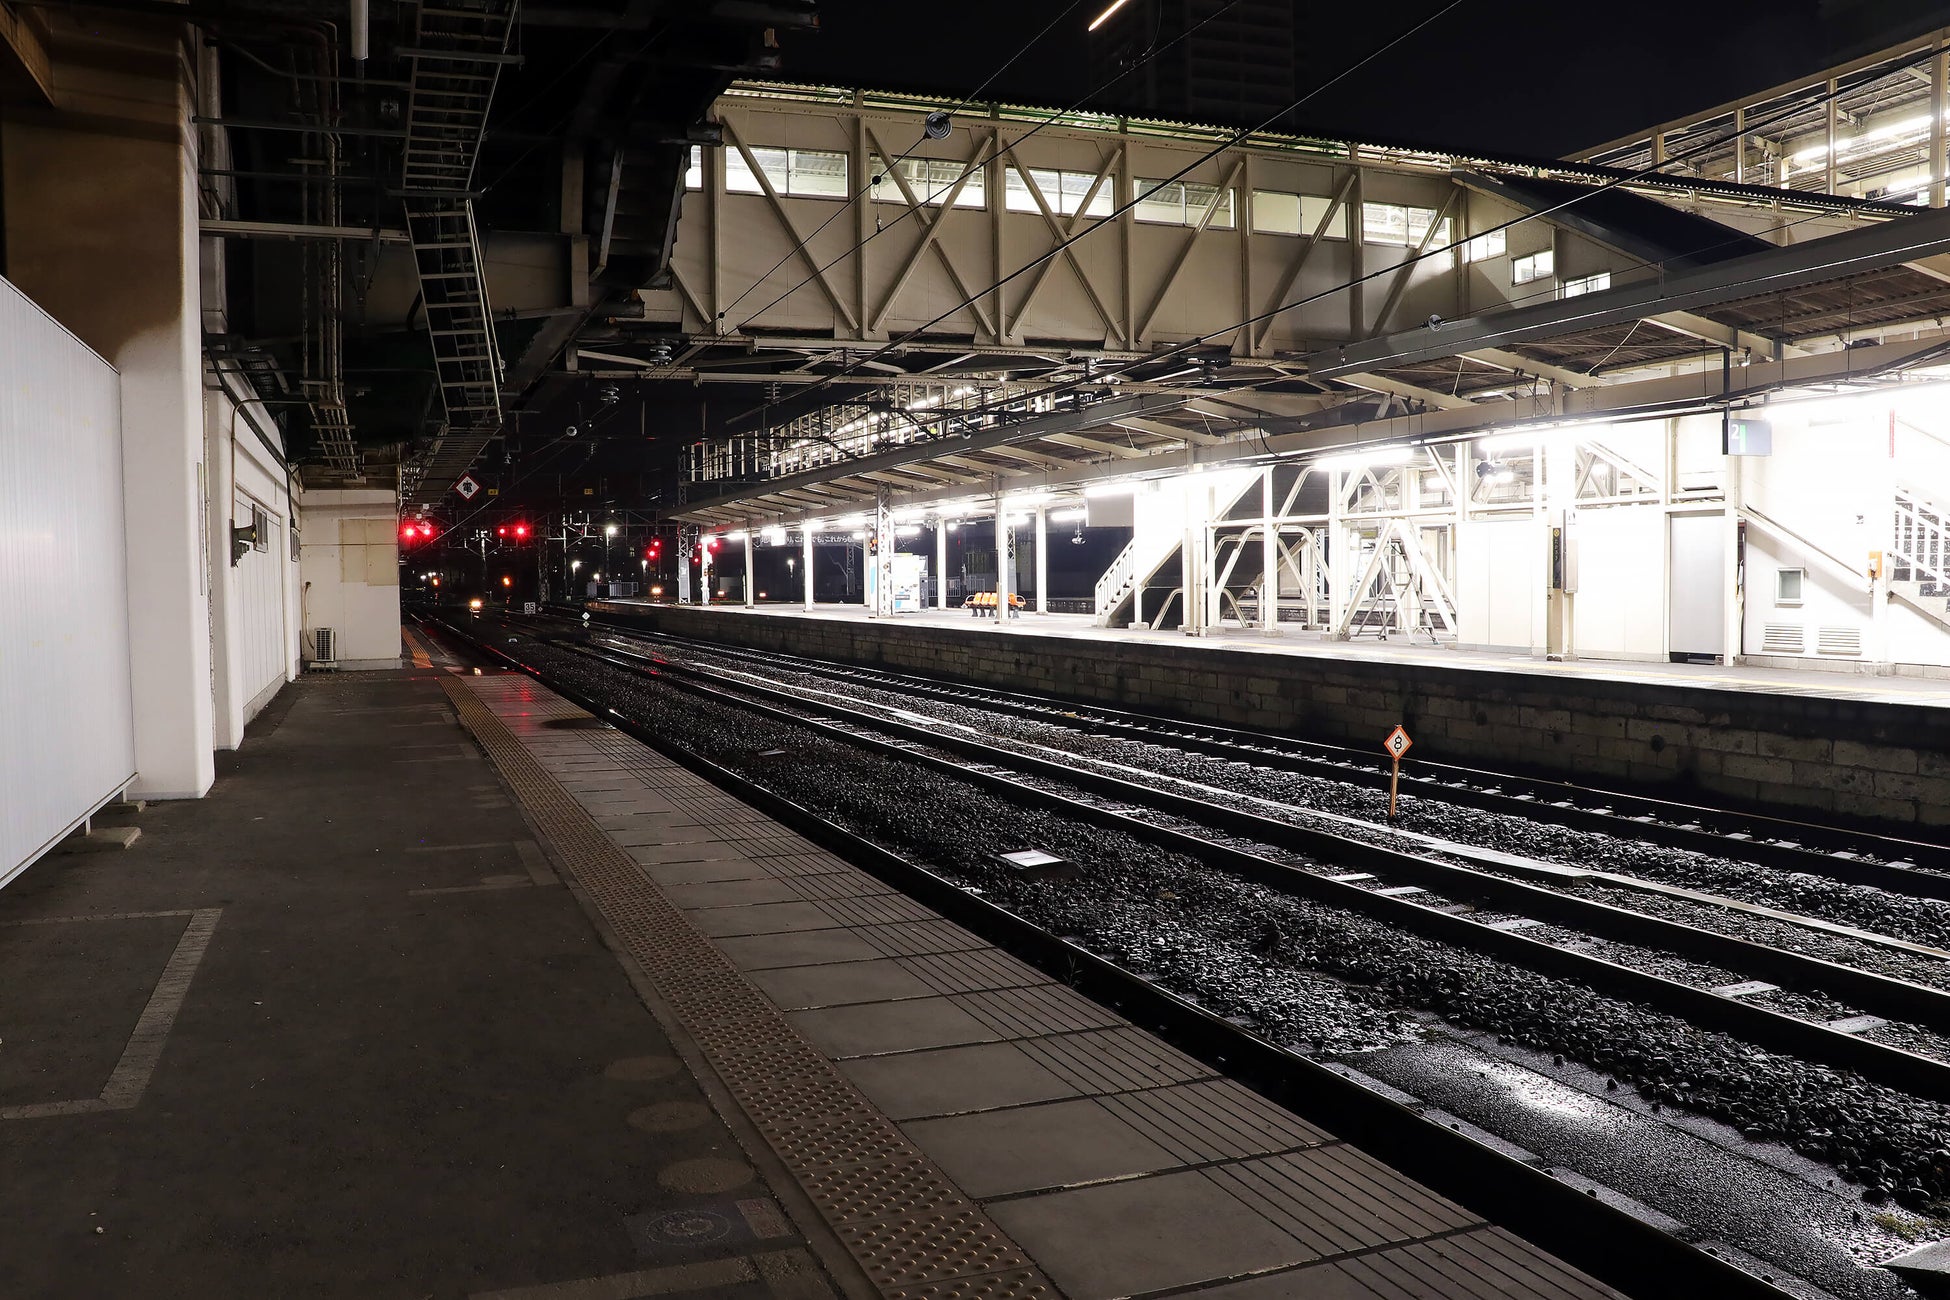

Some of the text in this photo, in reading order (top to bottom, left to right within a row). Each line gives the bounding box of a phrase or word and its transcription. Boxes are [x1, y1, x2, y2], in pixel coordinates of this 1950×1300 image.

[1731, 423, 1740, 440] 2
[525, 603, 535, 611] 35
[1393, 735, 1403, 750] 8
